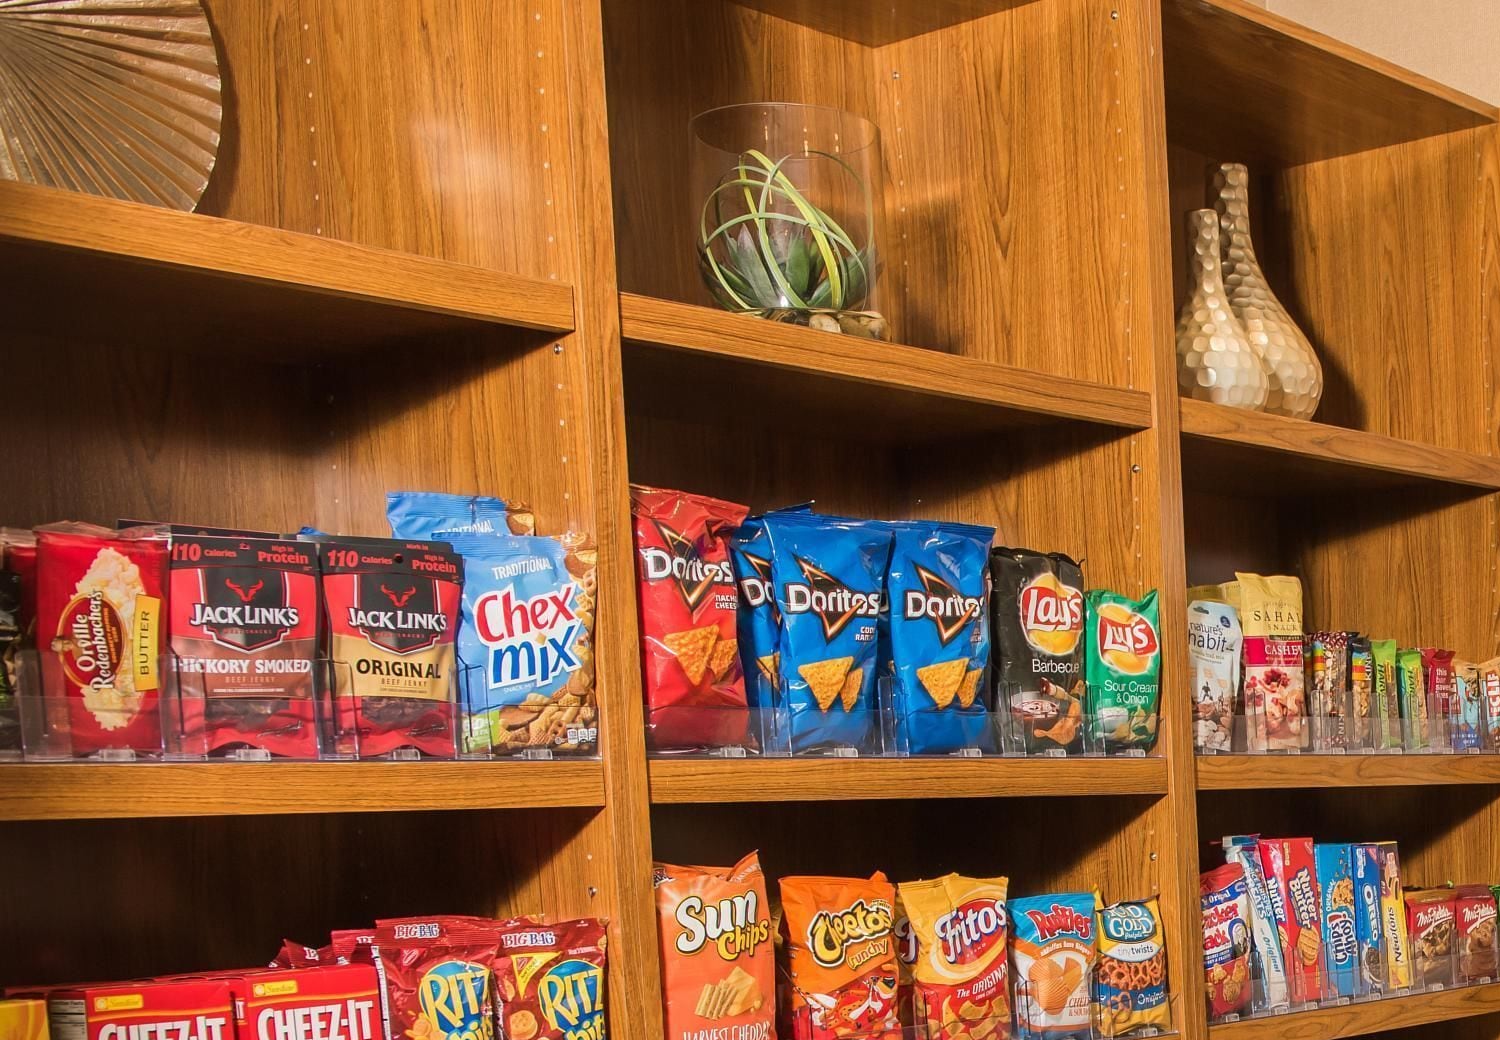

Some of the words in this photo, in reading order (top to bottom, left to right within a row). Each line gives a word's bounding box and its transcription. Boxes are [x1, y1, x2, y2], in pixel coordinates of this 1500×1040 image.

[172, 543, 201, 561] 110
[257, 551, 309, 564] Protein
[327, 550, 358, 567] 110
[361, 556, 393, 565] calories
[412, 559, 456, 573] Protein
[641, 548, 733, 583] Doritos
[492, 557, 552, 580] TRADITIONAL
[190, 603, 243, 626] JACK
[244, 604, 299, 626] LINK'S
[476, 585, 576, 644] Chex
[786, 584, 879, 615] Doritos
[1026, 588, 1083, 631] Lay's
[349, 607, 396, 630] JACK
[396, 610, 447, 632] LINK'S
[1189, 621, 1223, 636] nature's
[76, 613, 95, 673] Orville
[139, 611, 150, 676] BUTTER
[491, 624, 576, 684] mix
[1188, 630, 1227, 652] habit
[172, 658, 250, 674] HICKORY
[255, 659, 312, 673] SMOKED
[356, 658, 441, 679] ORIGINAL
[1032, 658, 1080, 674] Barbecue
[1104, 680, 1126, 693] Sour
[1128, 680, 1159, 694] Cream
[1116, 692, 1122, 703] &
[1123, 692, 1149, 704] Onion
[1266, 877, 1286, 922] Nutter
[1289, 878, 1312, 930] Butter
[1297, 867, 1318, 921] Nutter
[675, 889, 758, 954] Sun
[1026, 903, 1092, 942] Ruffles
[1109, 916, 1154, 938] GOLD
[1363, 884, 1380, 942] OREO
[395, 925, 416, 938] BIG
[502, 933, 528, 948] BIG
[529, 931, 555, 946] BAG
[717, 919, 769, 962] Chips
[812, 900, 893, 964] Cheetos
[934, 899, 1007, 963] Fritos
[1331, 922, 1348, 964] Chips
[1387, 907, 1402, 962] Newtons
[846, 938, 889, 970] Crunchy
[1131, 944, 1154, 955] twists
[1262, 935, 1281, 973] Original
[420, 968, 491, 1036] RITZ
[539, 968, 604, 1032] RITZ
[956, 988, 971, 998] The
